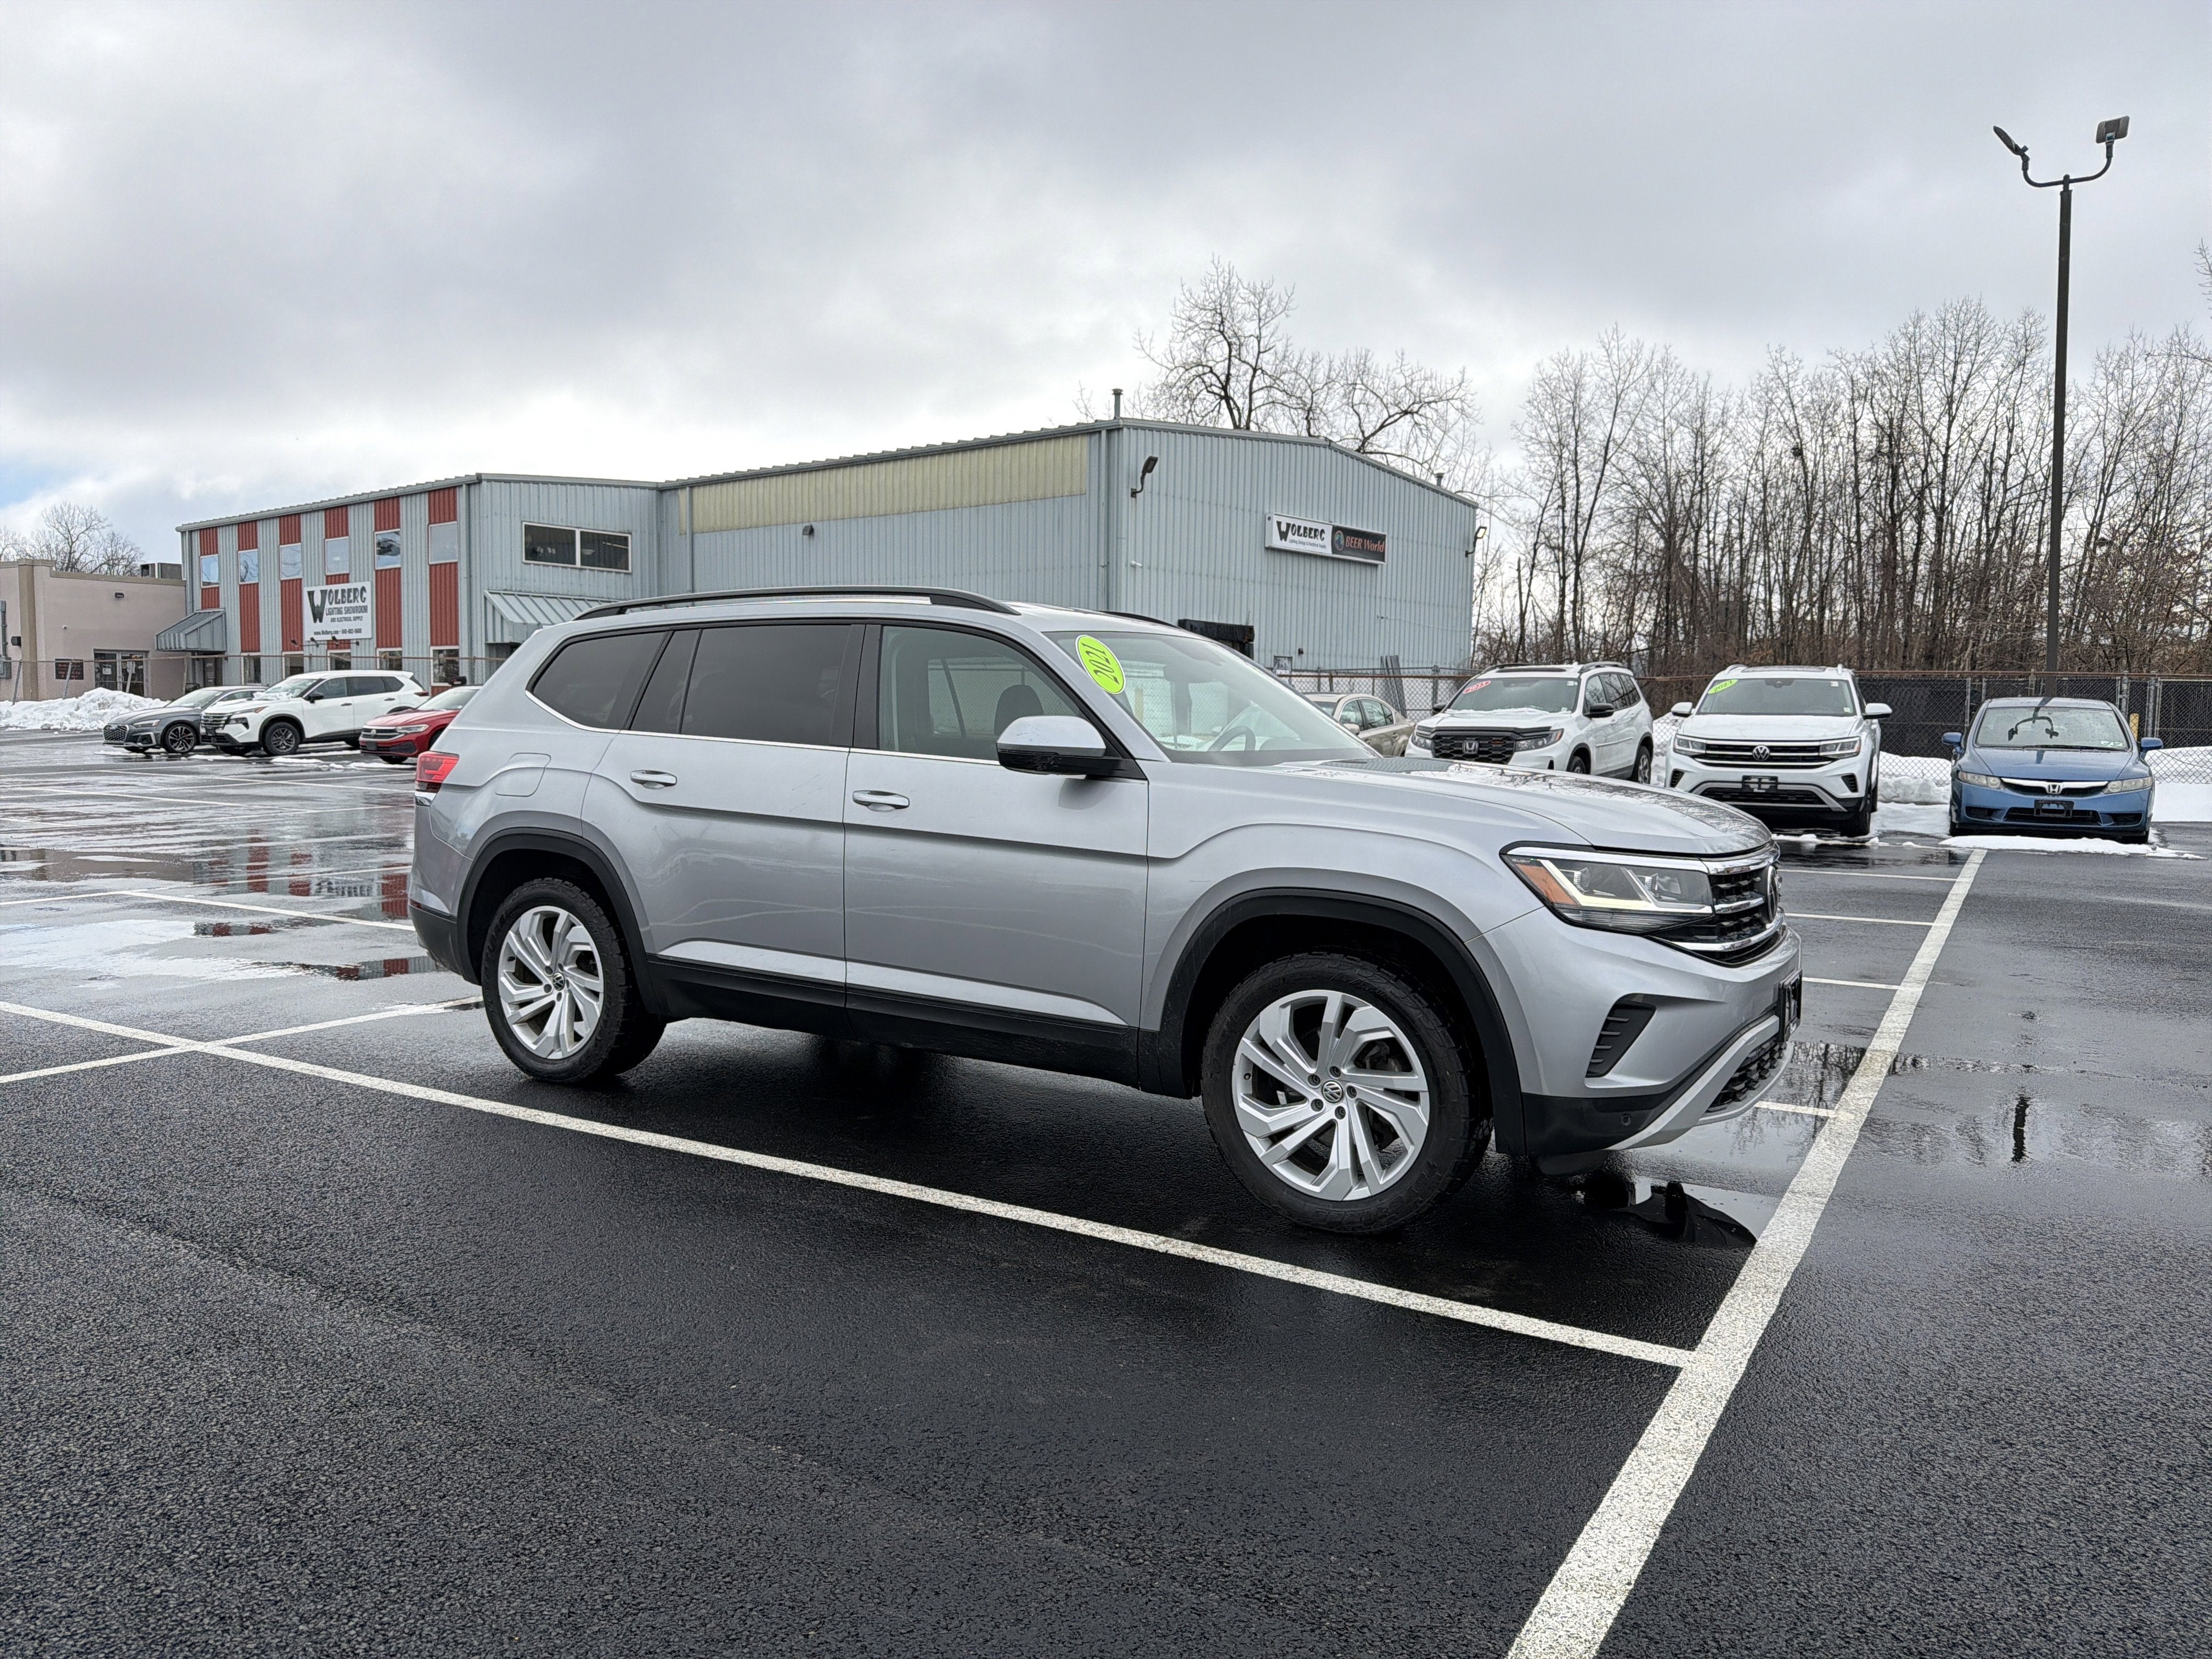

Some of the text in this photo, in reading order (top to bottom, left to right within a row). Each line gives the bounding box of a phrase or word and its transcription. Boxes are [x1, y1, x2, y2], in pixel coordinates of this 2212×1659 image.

[1276, 521, 1325, 541] WOLBERG
[1346, 536, 1385, 552] BEER World
[307, 586, 367, 623] WOLBERG
[1081, 642, 1120, 685] 2021
